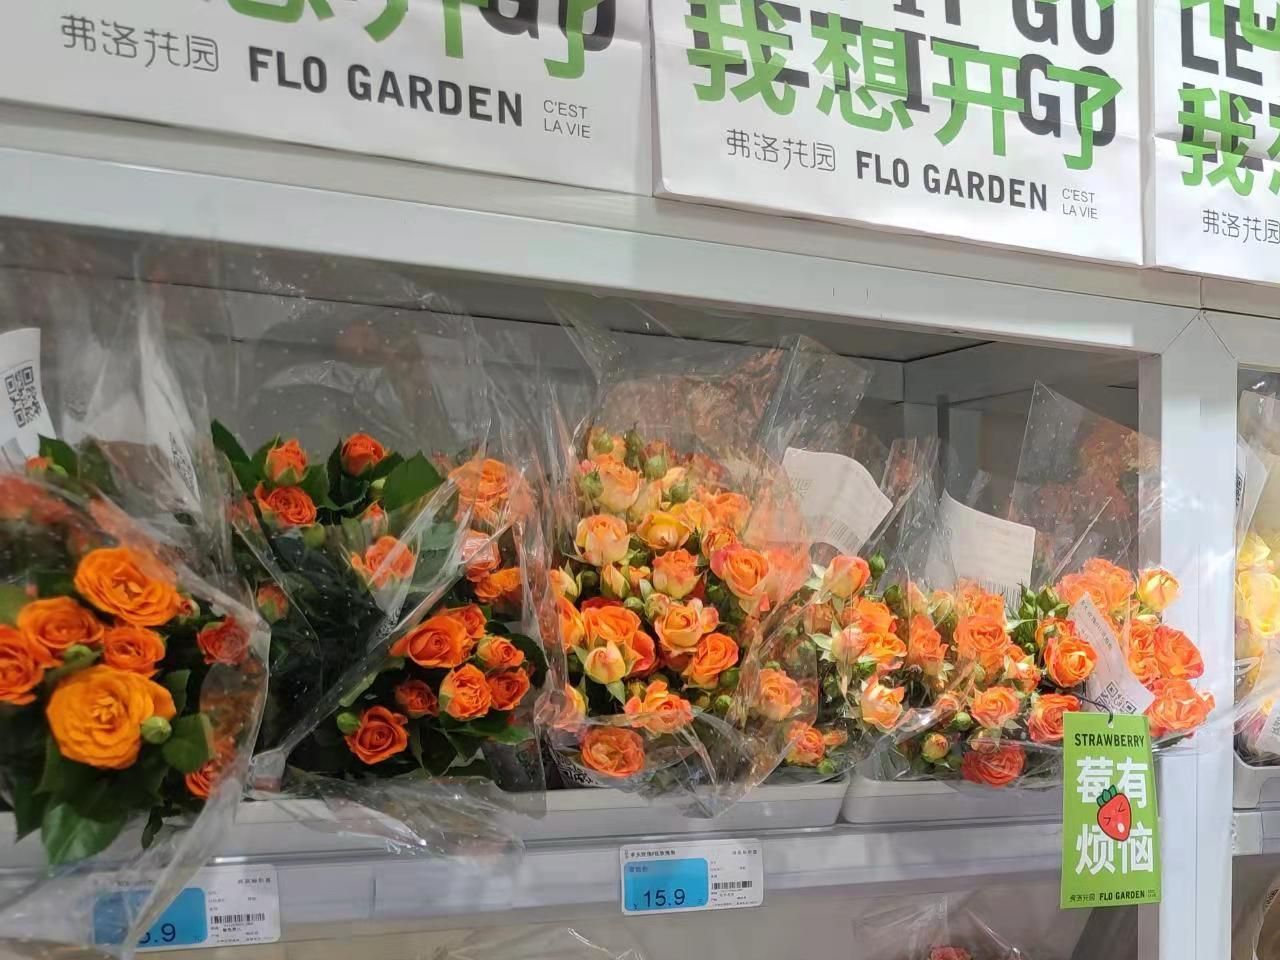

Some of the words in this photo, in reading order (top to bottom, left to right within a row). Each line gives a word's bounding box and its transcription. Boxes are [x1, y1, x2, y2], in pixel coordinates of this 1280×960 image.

[60, 15, 219, 73] 弗洛花园
[248, 45, 328, 93] FLO
[347, 64, 523, 127] GARDEN
[684, 0, 1123, 170] 我想开了
[543, 99, 588, 120] C'EST
[544, 117, 563, 135] LA
[564, 121, 591, 139] VIE
[726, 129, 836, 172] 弗洛花园
[856, 151, 909, 188] FLO
[923, 164, 1047, 211] GARDEN
[1062, 188, 1095, 203] C'EST
[1062, 204, 1079, 217] LA
[1079, 206, 1098, 220] VIE
[1202, 209, 1280, 244] 弗洛花园
[1074, 733, 1145, 748] STRAWBERRY
[1076, 756, 1149, 809] 莓有
[1075, 823, 1154, 876] 烦恼
[644, 888, 686, 907] 15.9
[1099, 892, 1113, 902] FLO
[1115, 890, 1145, 900] GARDEN
